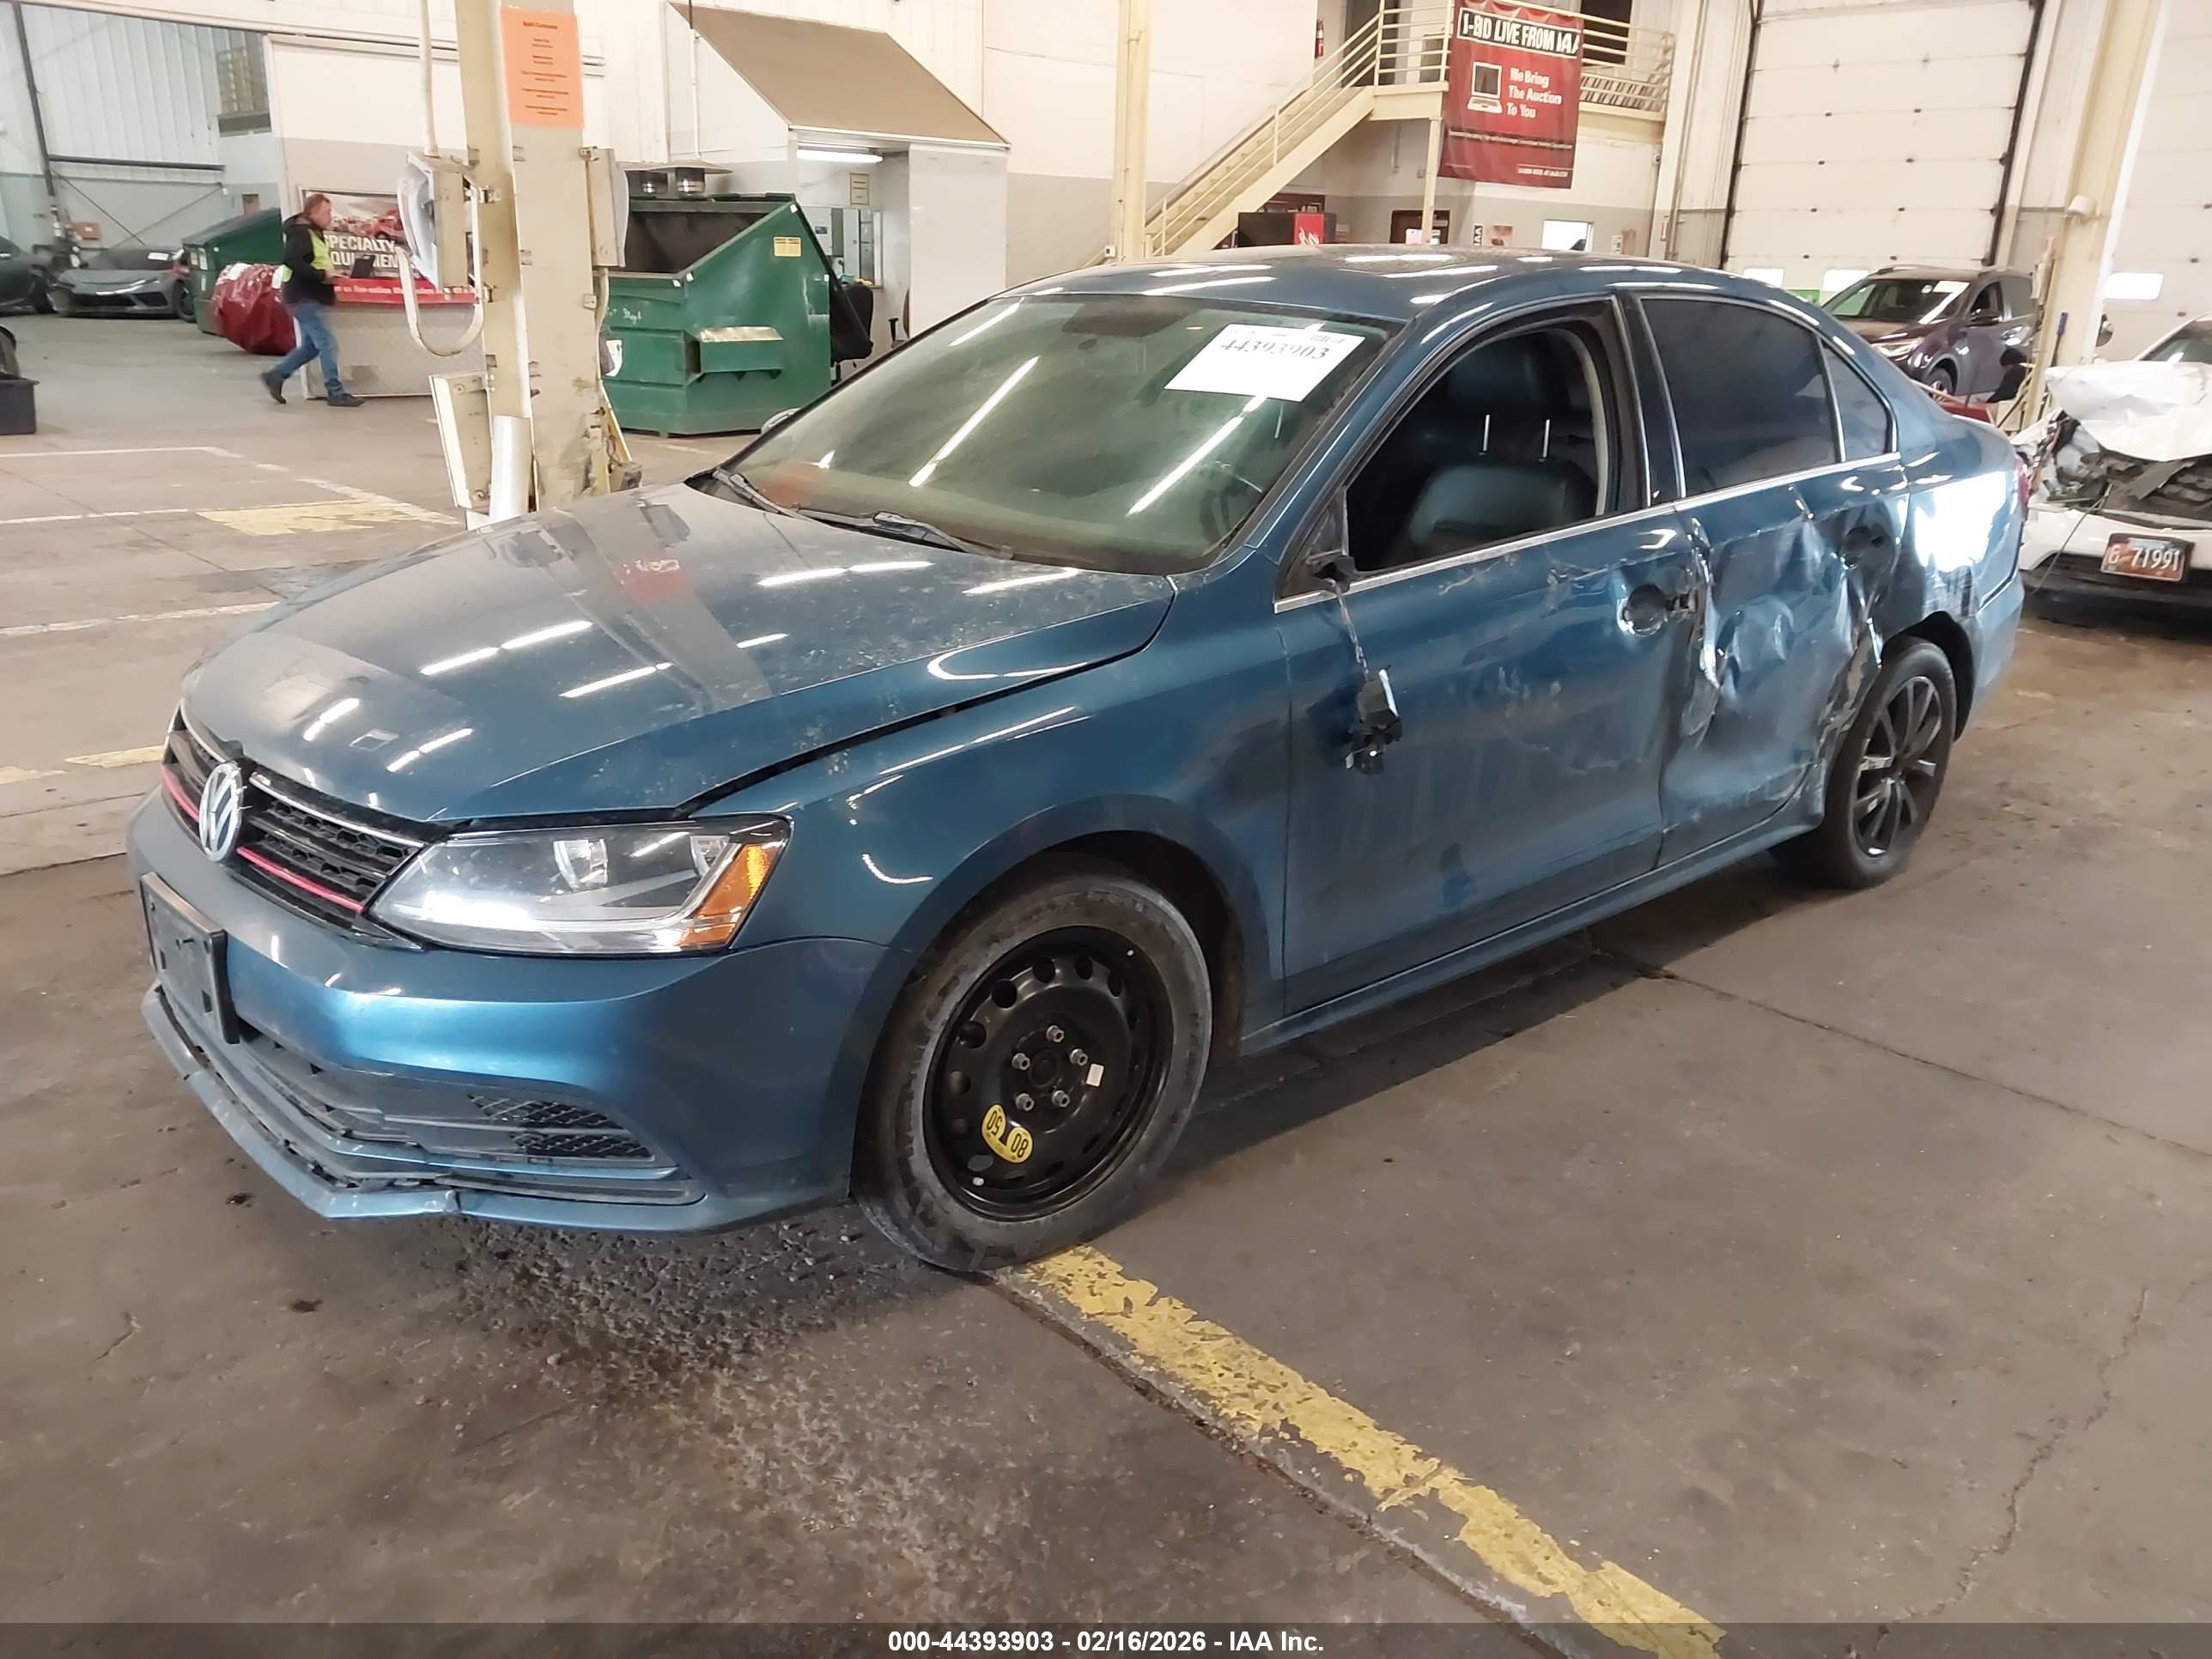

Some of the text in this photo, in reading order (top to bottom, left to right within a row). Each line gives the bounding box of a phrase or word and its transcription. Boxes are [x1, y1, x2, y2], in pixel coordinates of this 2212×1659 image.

[1493, 20, 1520, 45] LIVE
[1521, 25, 1556, 51] FROM
[1510, 67, 1550, 88] We Bring
[1509, 85, 1562, 105] The Auction
[1506, 102, 1536, 118] To You
[2131, 547, 2181, 571] 71991
